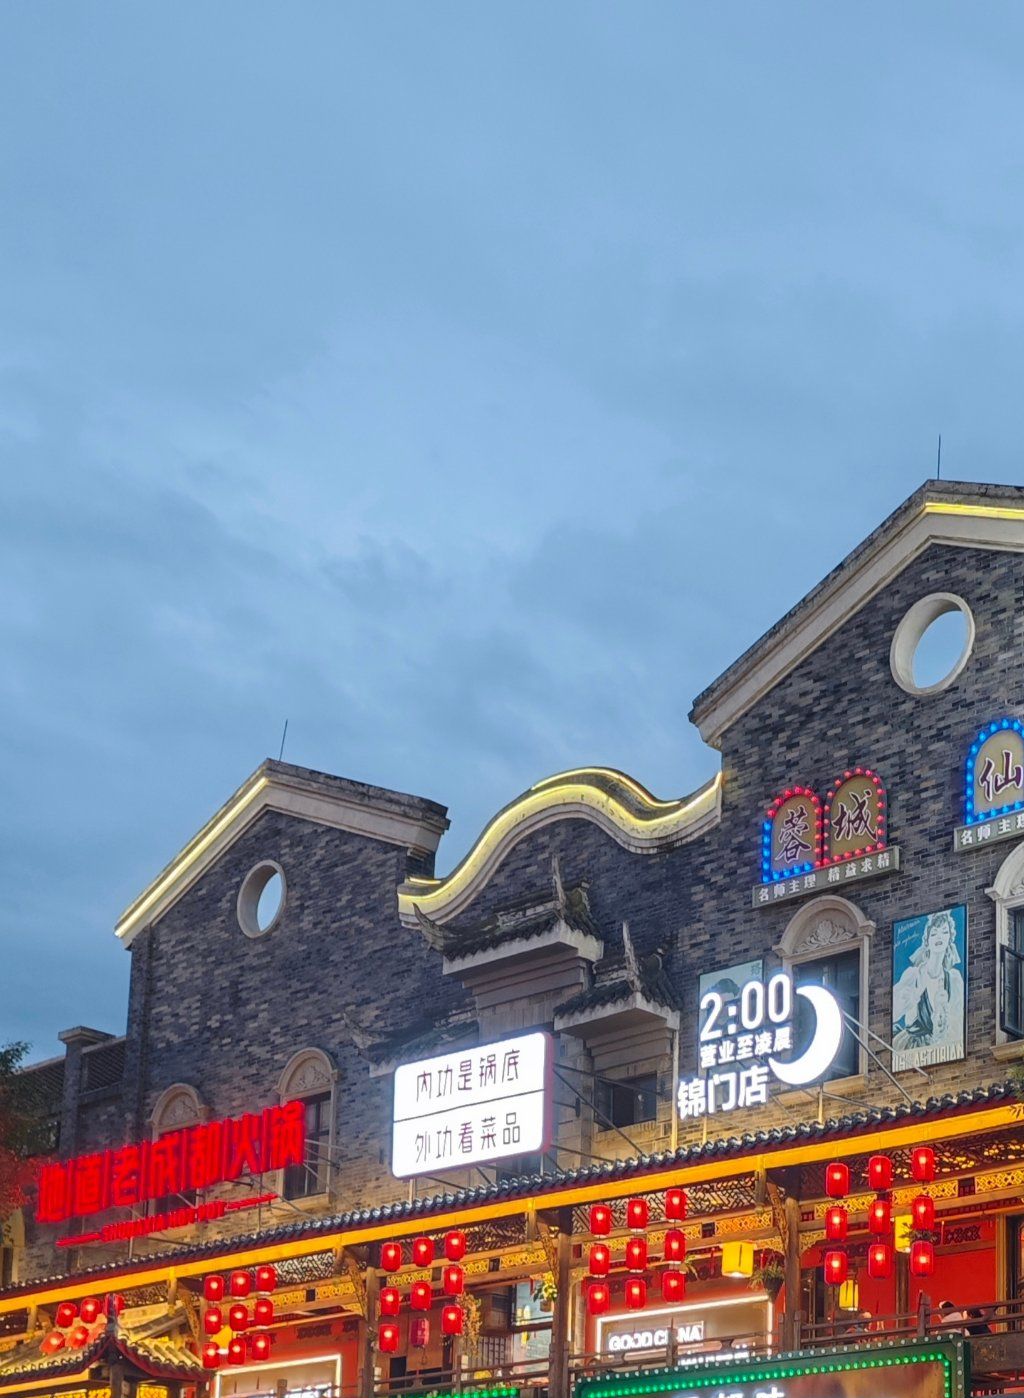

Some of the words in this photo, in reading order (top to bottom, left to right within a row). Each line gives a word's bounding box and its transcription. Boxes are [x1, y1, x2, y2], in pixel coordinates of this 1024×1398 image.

[775, 789, 878, 864] 蓉城
[827, 852, 890, 883] 精益求精
[700, 973, 791, 1042] 2:00
[700, 1026, 793, 1069] 营业至凌晨
[416, 1048, 521, 1103] 内功是锅底
[677, 1065, 769, 1120] 锦门店
[415, 1112, 521, 1164] 外功看菜品
